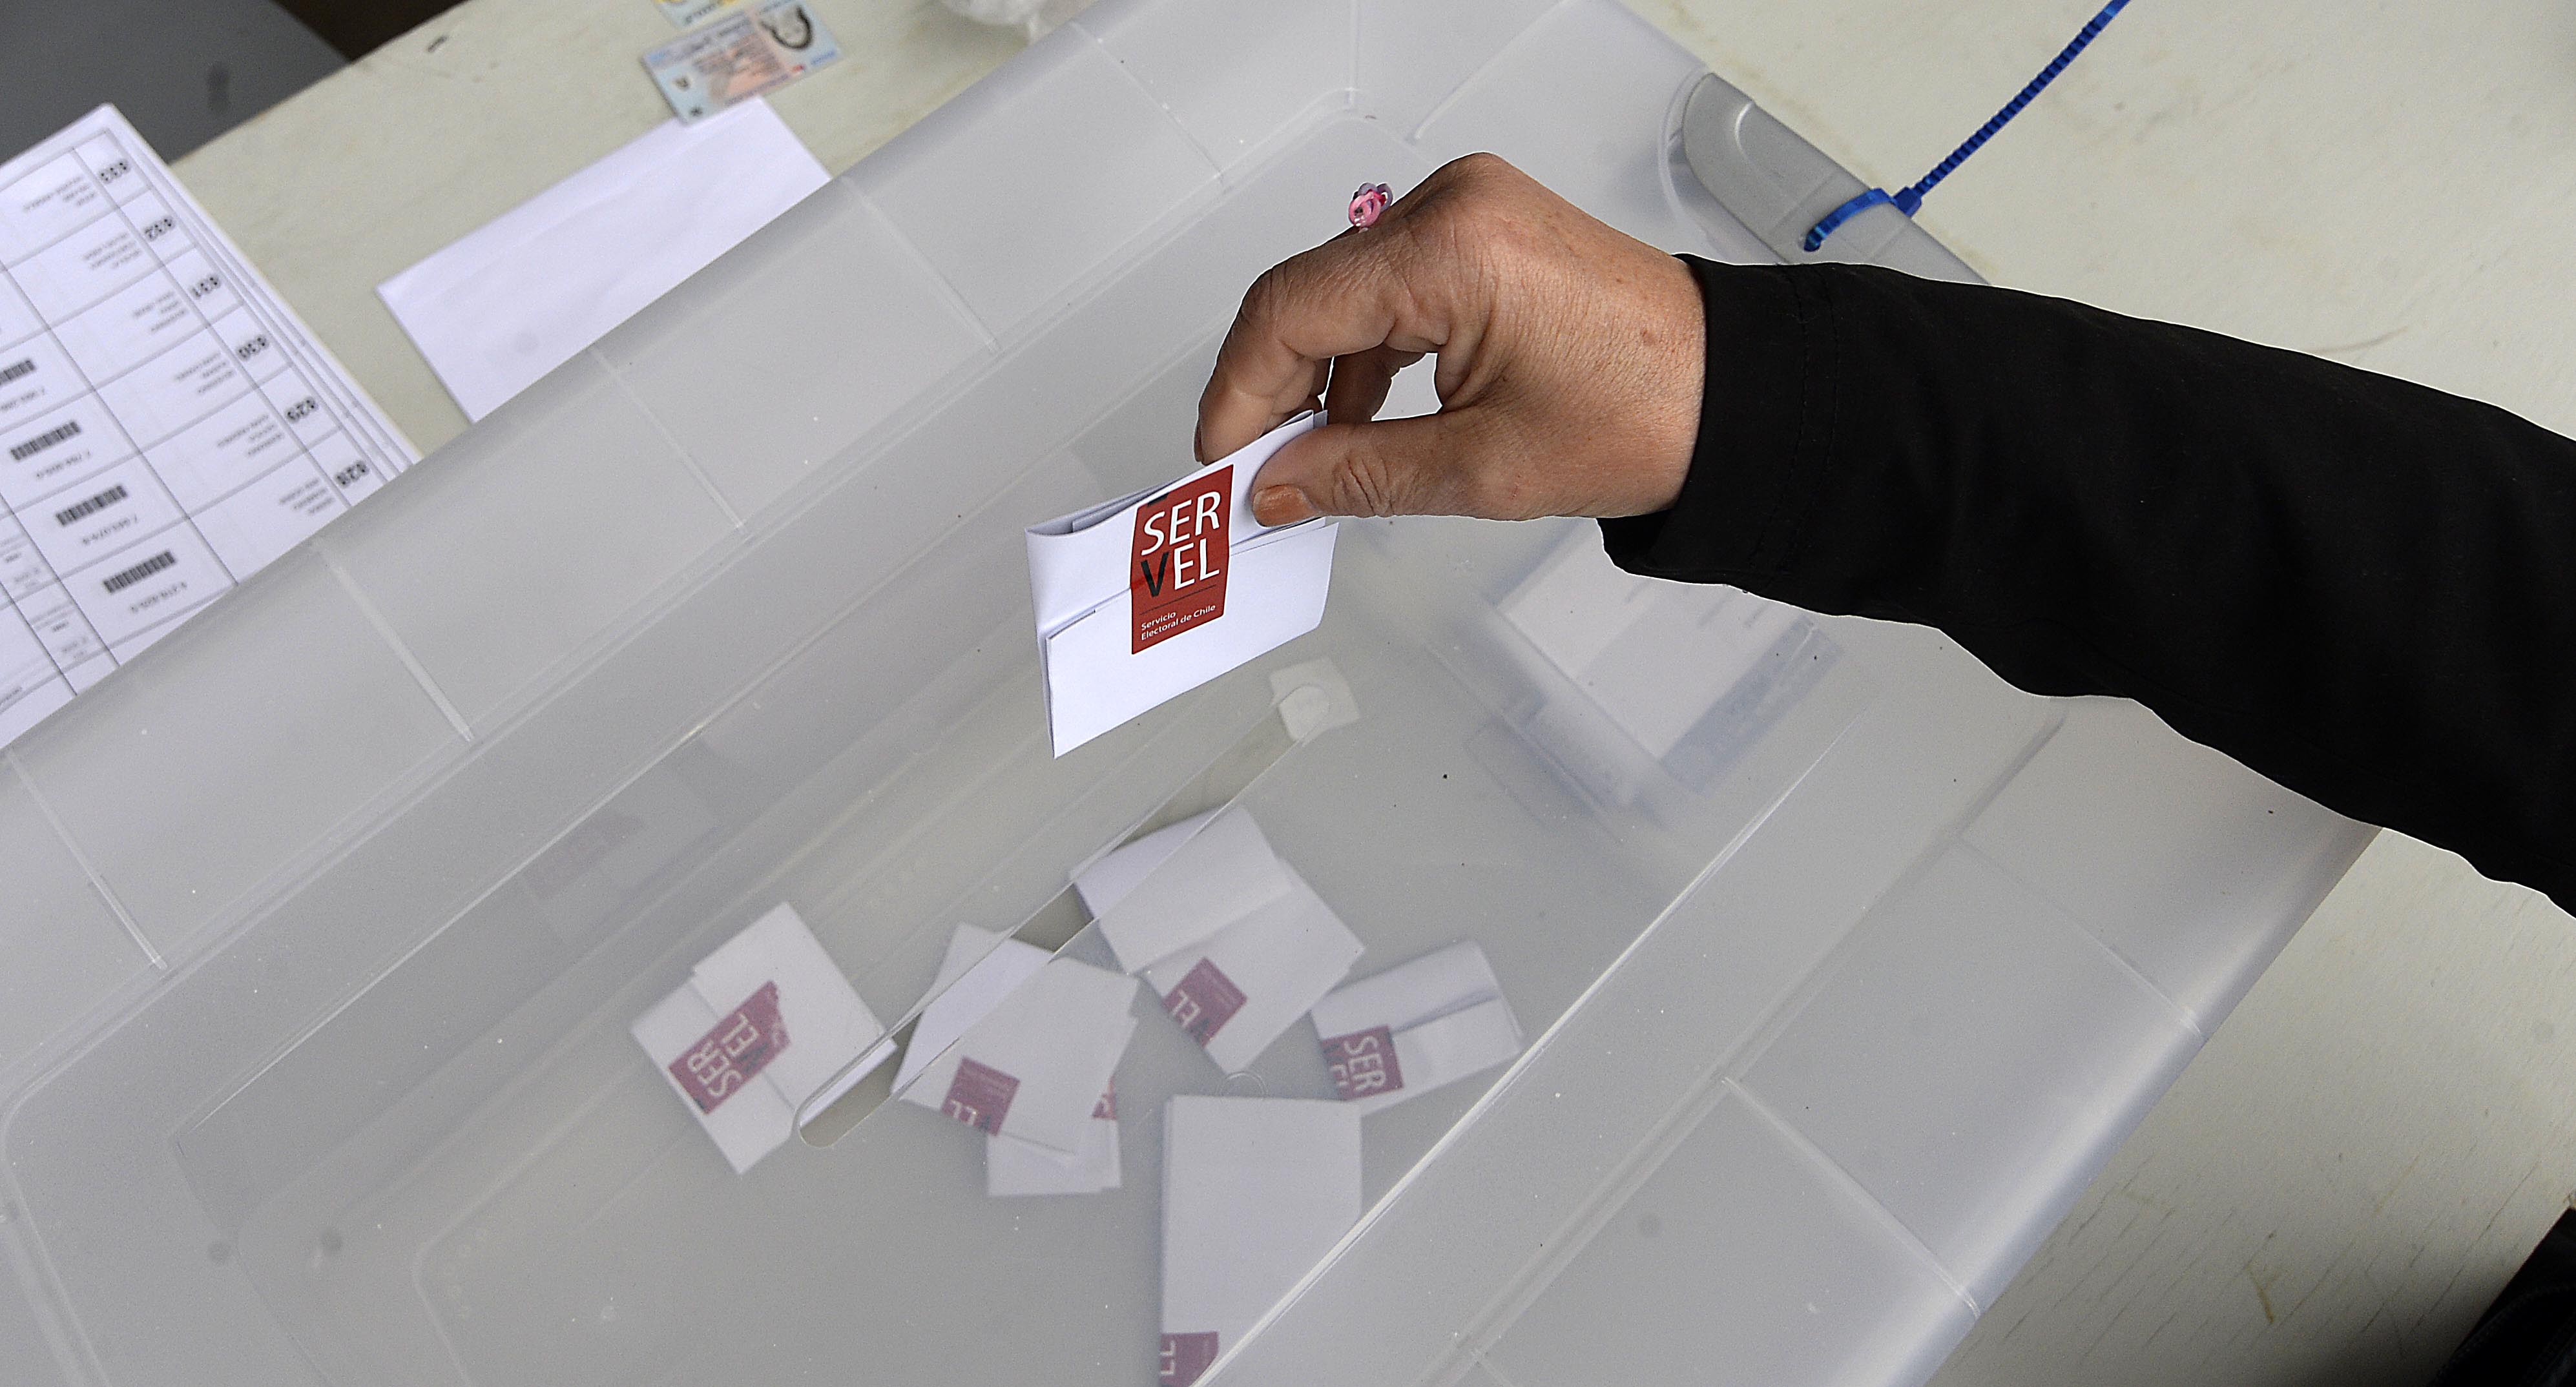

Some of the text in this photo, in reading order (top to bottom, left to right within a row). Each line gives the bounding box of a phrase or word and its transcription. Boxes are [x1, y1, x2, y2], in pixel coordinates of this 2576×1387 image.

[1141, 491, 1221, 556] SER
[1141, 538, 1220, 597] VEL
[1141, 611, 1176, 631] Servicio
[1141, 604, 1216, 641] Electoral de Chile
[687, 1040, 743, 1097] SER
[1344, 1035, 1386, 1091] SER
